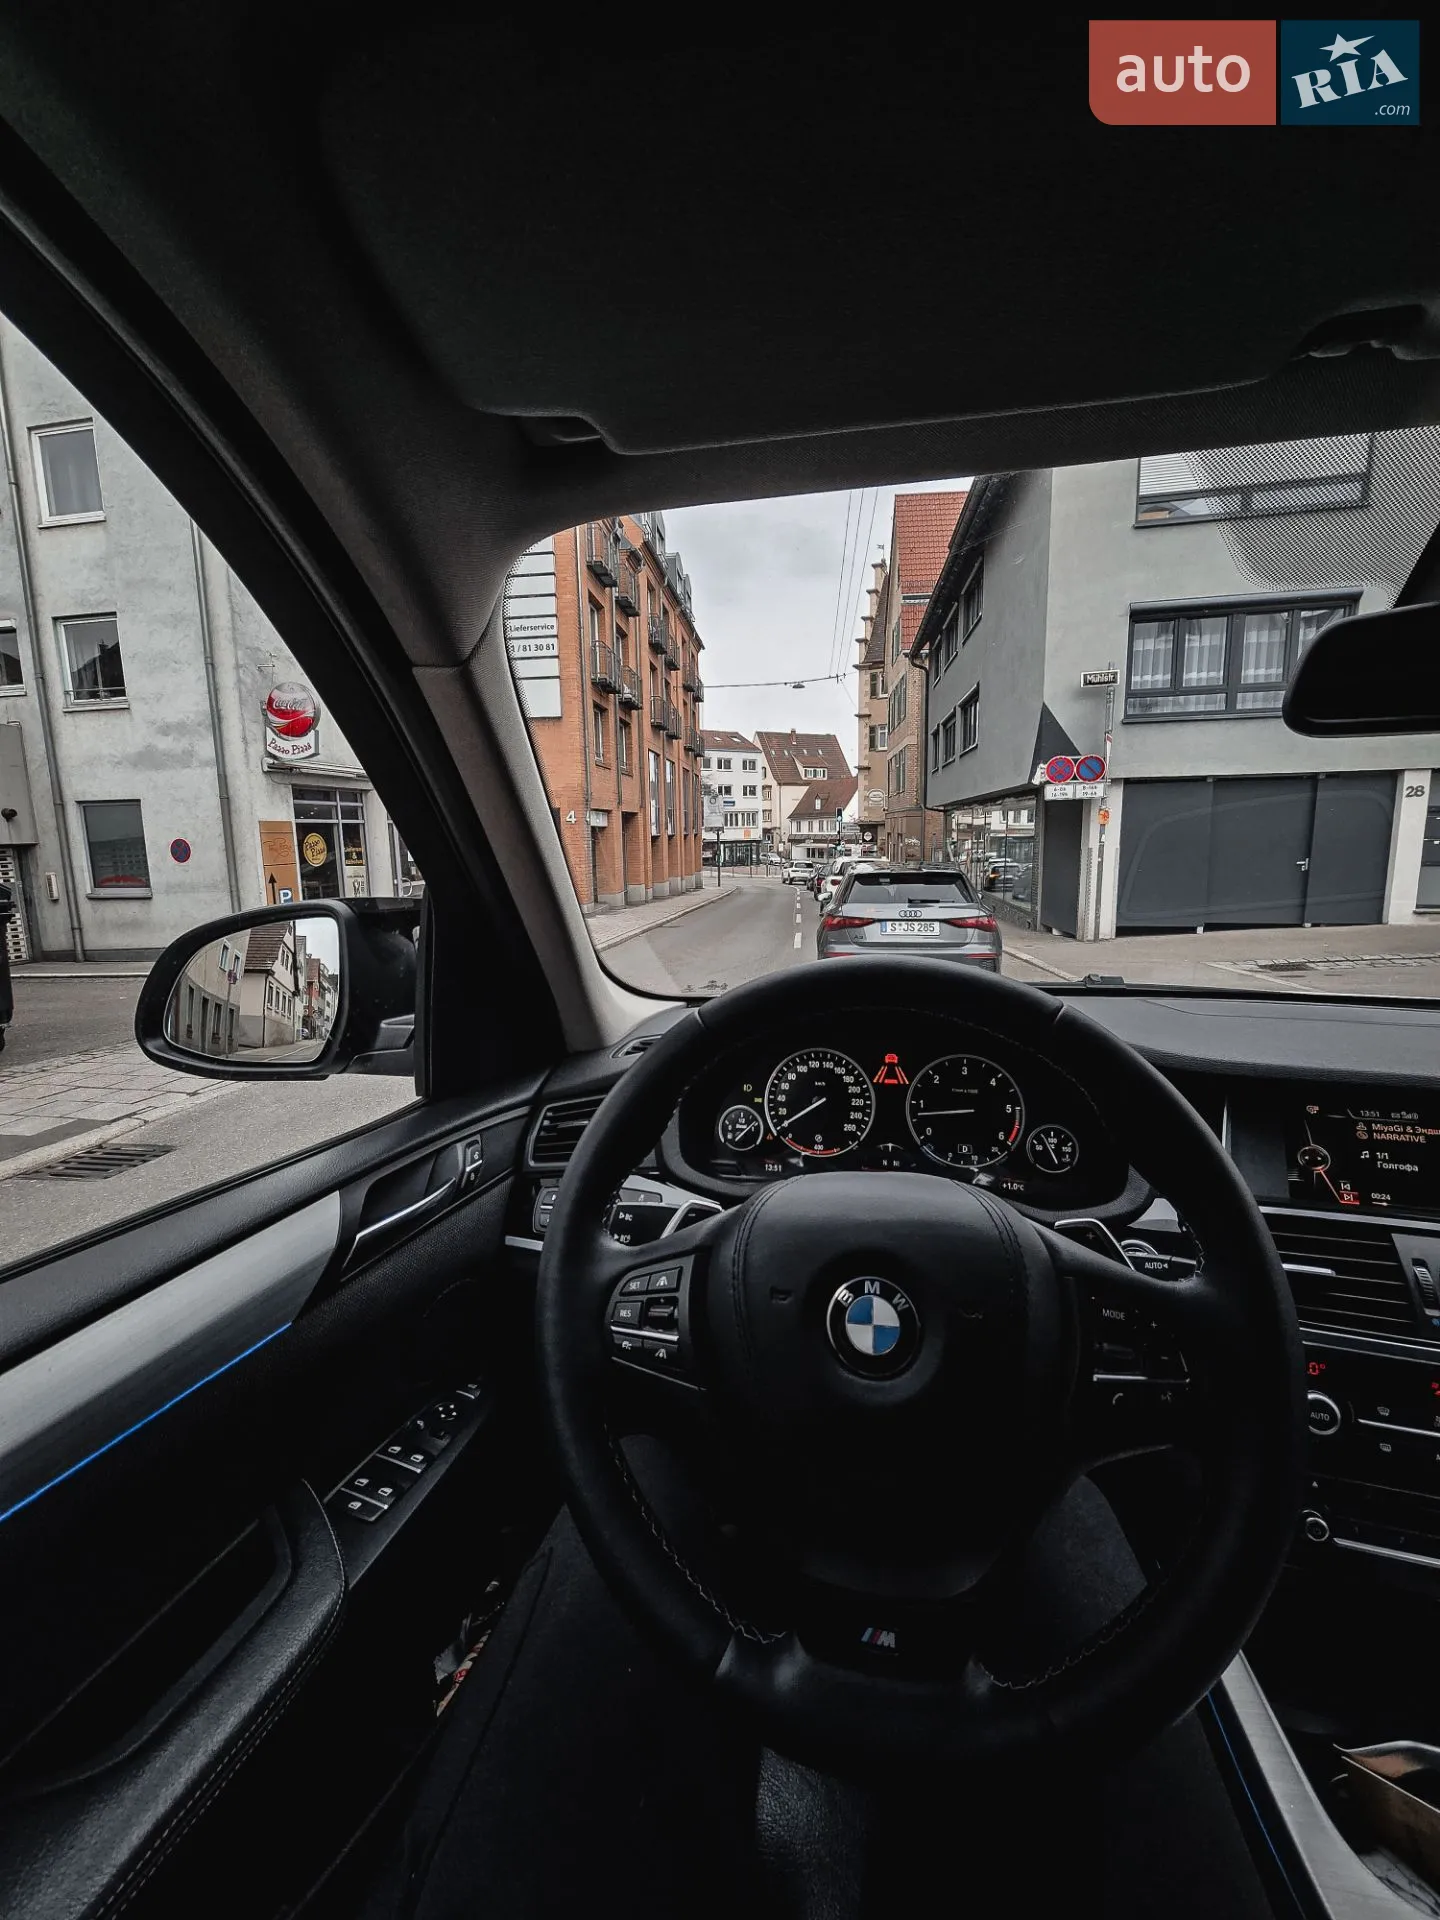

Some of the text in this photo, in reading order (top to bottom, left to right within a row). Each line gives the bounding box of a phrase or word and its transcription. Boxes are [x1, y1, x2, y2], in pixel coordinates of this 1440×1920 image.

[510, 622, 555, 632] Lieferservice
[522, 644, 532, 652] 81
[534, 643, 544, 651] 30
[545, 643, 555, 651] 81
[1405, 785, 1425, 798] 28
[565, 810, 577, 824] 4
[280, 889, 292, 903] P
[890, 922, 936, 932] S JS 285
[797, 1065, 808, 1073] 100
[808, 1061, 820, 1069] 120
[961, 1067, 968, 1075] 3
[843, 1075, 855, 1083] 180
[933, 1075, 940, 1084] 2
[989, 1078, 997, 1087] 4
[848, 1086, 861, 1094] 200
[777, 1094, 786, 1102] 40
[851, 1098, 864, 1106] 220
[919, 1100, 925, 1109] 1
[778, 1107, 787, 1115] 20
[1005, 1105, 1012, 1114] 5
[849, 1112, 862, 1120] 240
[843, 1123, 856, 1131] 260
[998, 1132, 1005, 1140] 6
[1373, 1132, 1427, 1143] NARRATIVE
[962, 1145, 969, 1153] D
[1376, 1152, 1389, 1160] 1/1
[1377, 1161, 1419, 1172] Голгофа
[1144, 1261, 1164, 1269] AUTO
[629, 1281, 640, 1289] SET
[837, 1280, 909, 1310] BMW
[620, 1309, 632, 1318] RES
[1102, 1307, 1126, 1320] MODE
[1310, 1411, 1330, 1421] AUTO
